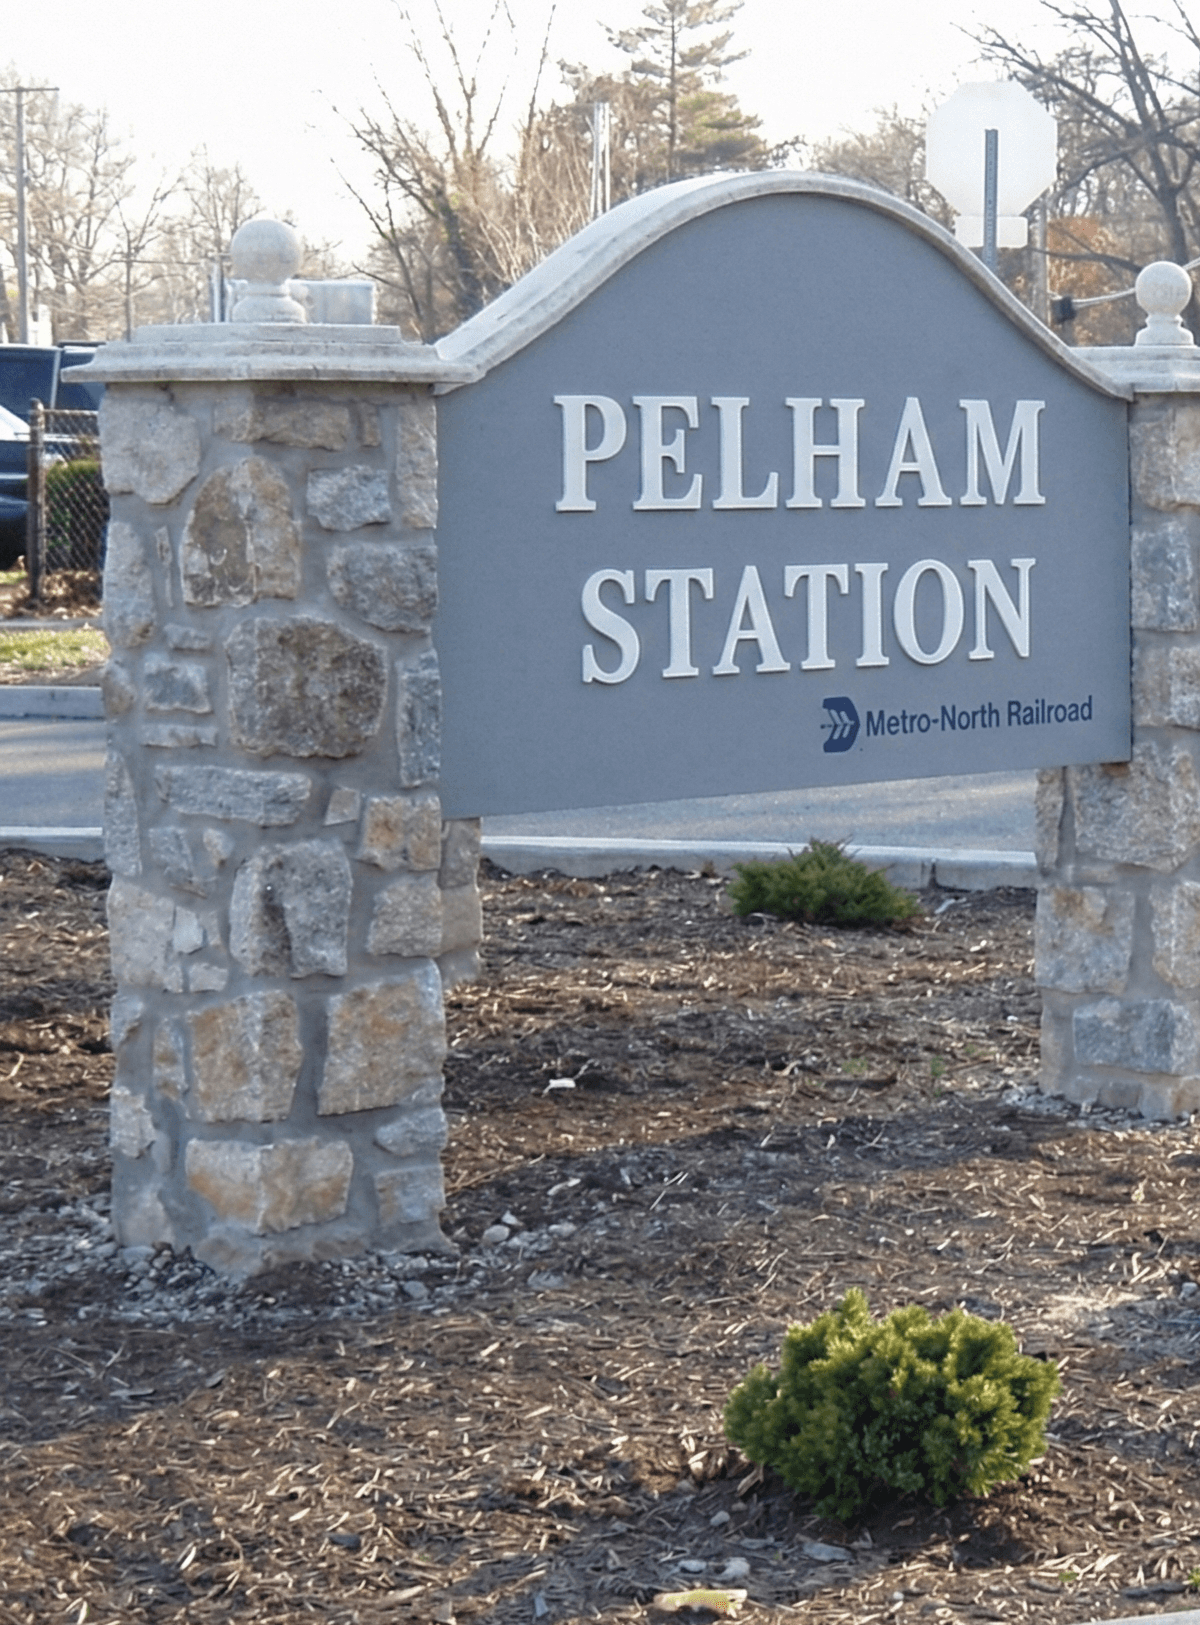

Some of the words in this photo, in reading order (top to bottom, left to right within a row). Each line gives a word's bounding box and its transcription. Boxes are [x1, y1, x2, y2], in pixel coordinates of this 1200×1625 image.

[554, 395, 1046, 512] PELHAM
[581, 558, 1036, 684] STATION
[865, 702, 1000, 737] Metro-North
[1007, 695, 1093, 727] Railroad
